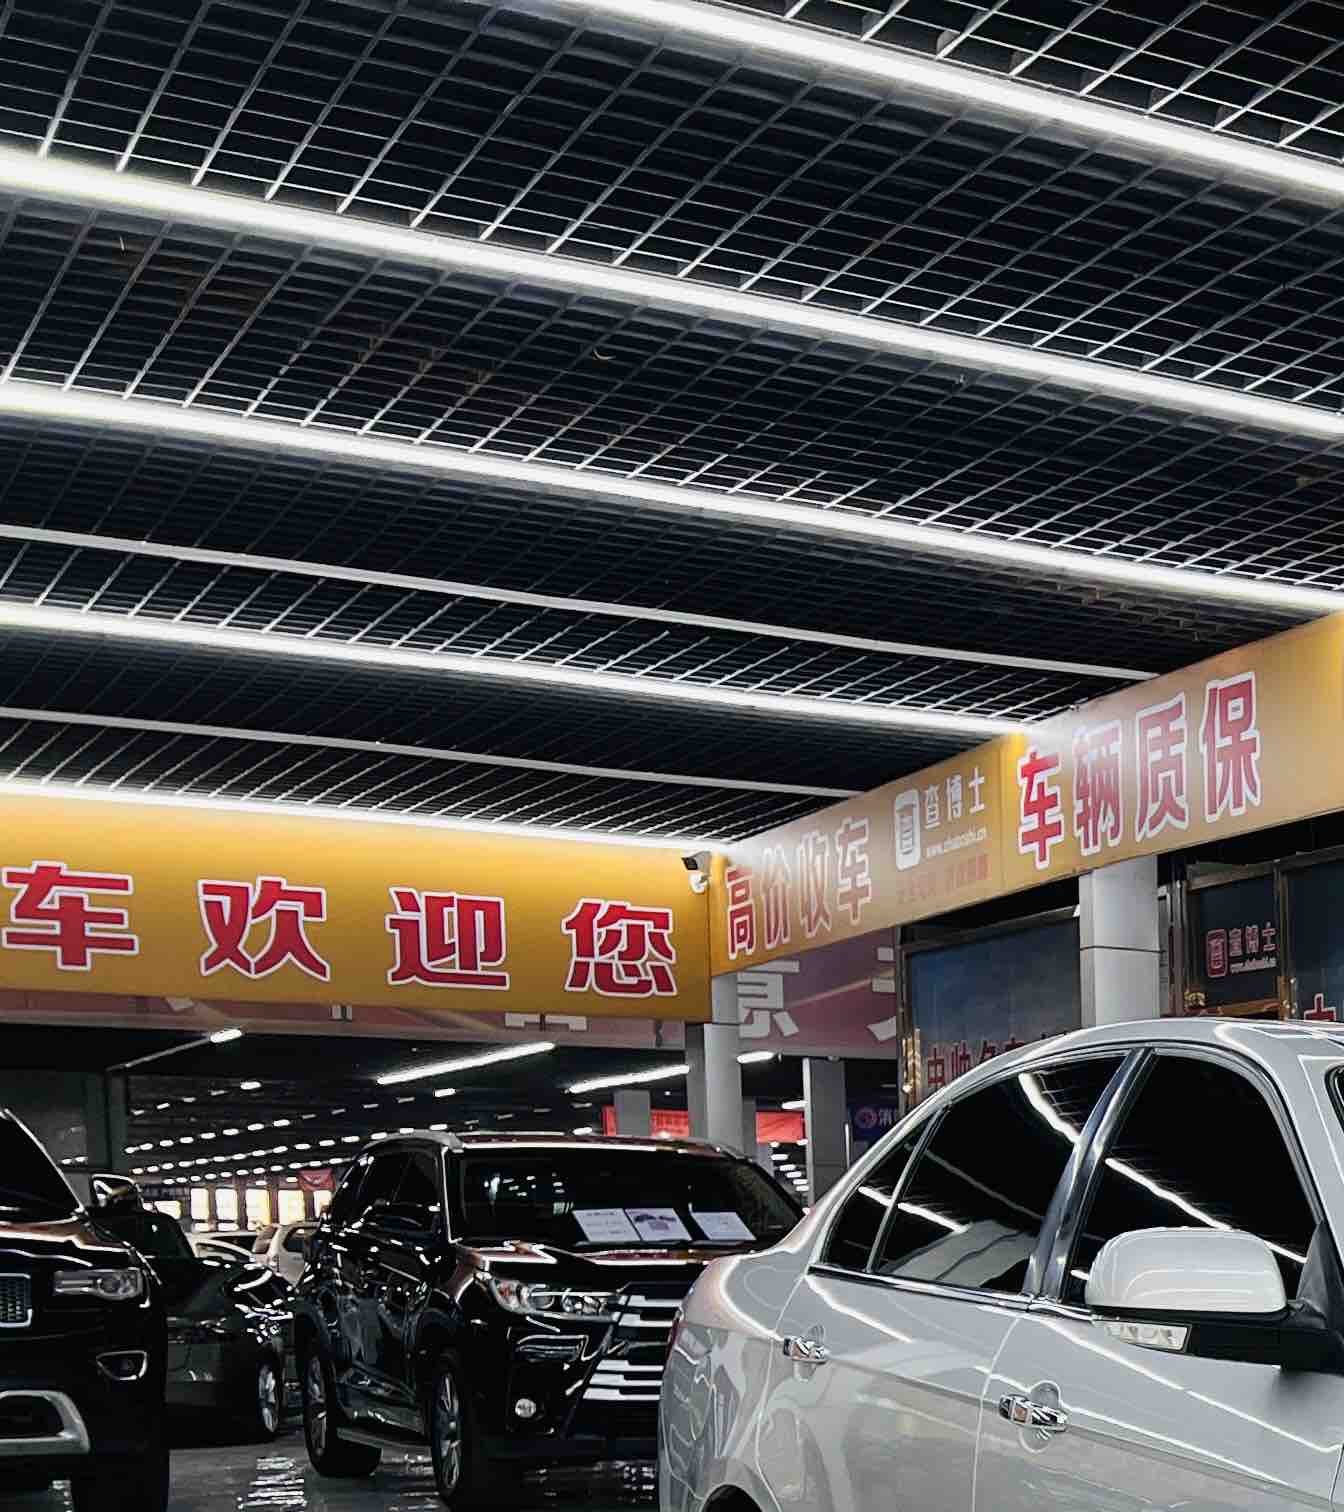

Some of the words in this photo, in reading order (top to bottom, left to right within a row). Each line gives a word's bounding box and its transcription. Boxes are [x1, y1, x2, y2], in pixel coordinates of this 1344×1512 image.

[1016, 671, 1261, 870] 车辆质保
[1, 860, 679, 998] 车欢迎您
[725, 813, 873, 961] 高价收车
